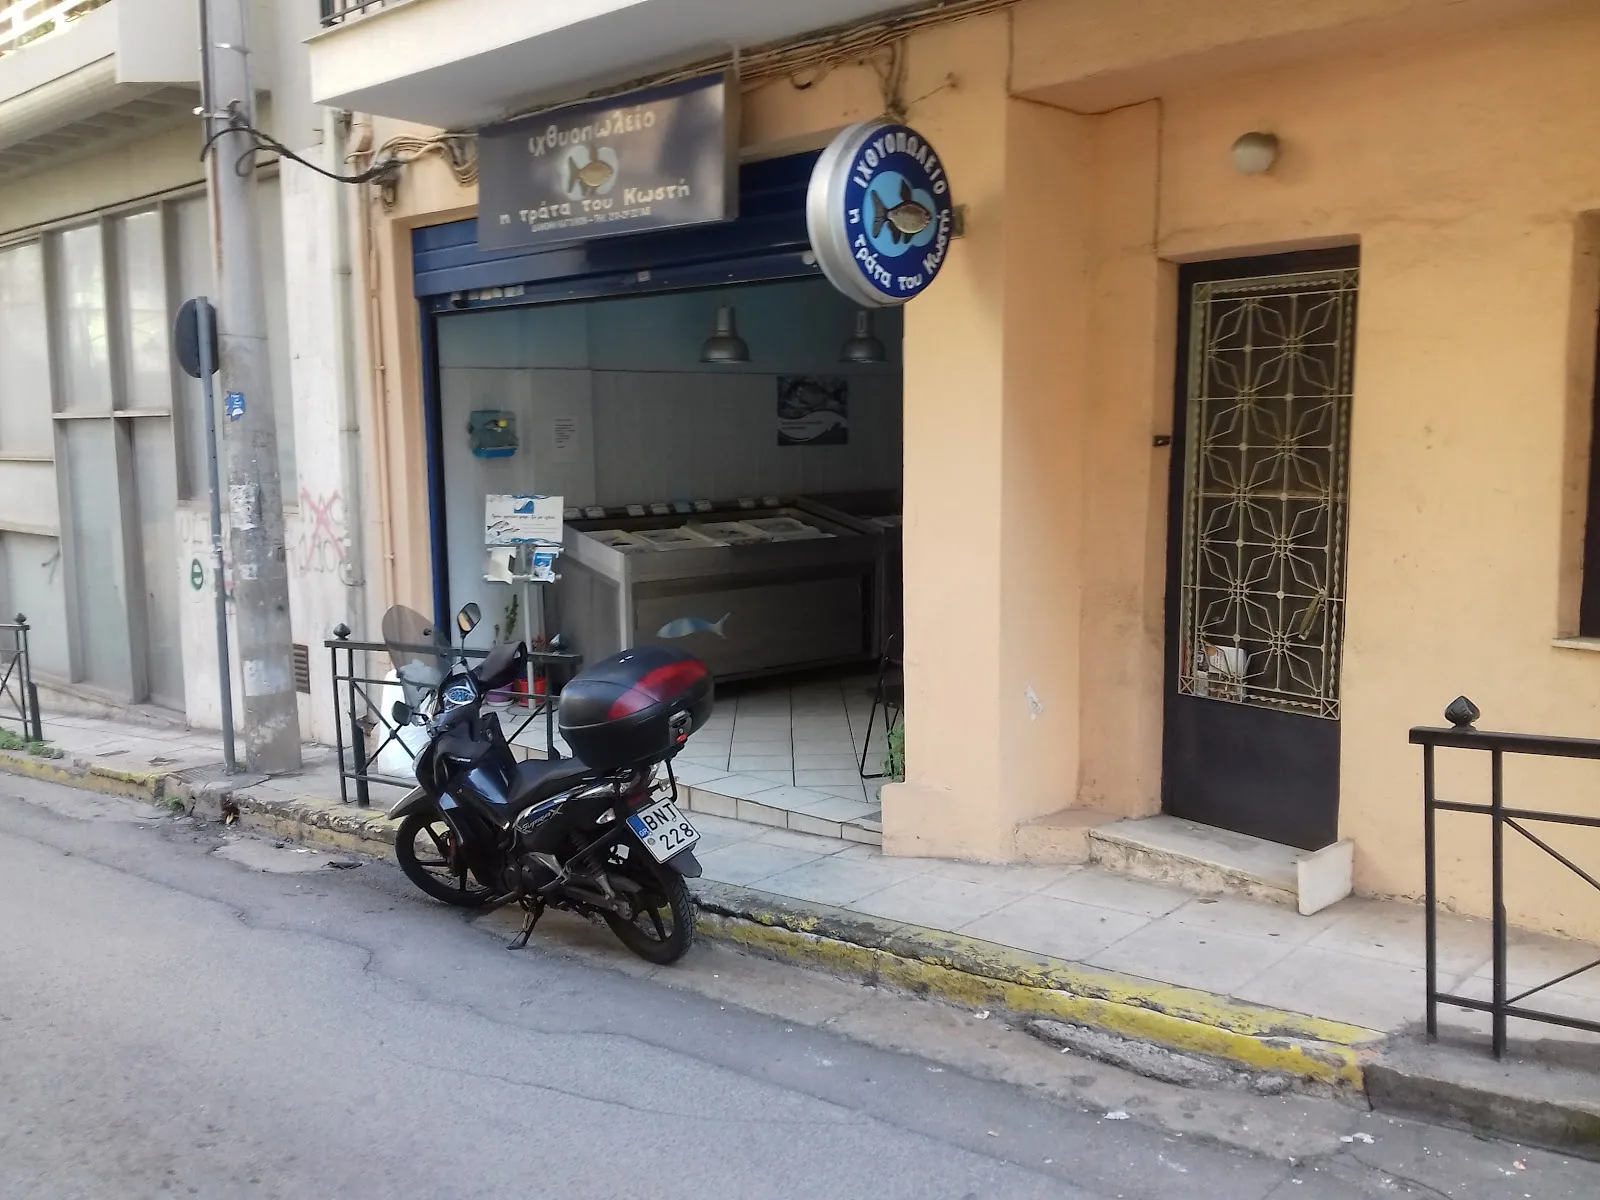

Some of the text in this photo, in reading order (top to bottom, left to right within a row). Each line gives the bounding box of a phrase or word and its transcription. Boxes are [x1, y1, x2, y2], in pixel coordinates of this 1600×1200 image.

[528, 105, 656, 157] ιχθυοπωλείο
[853, 132, 948, 195] ΙΧΘΥΟΠΩΛΕΙΟ
[519, 200, 572, 226] τράτα
[582, 196, 614, 213] του
[623, 178, 692, 206] Κωστή
[848, 208, 950, 291] η τράτα του Κωστή
[638, 827, 650, 838] GR
[642, 803, 678, 831] BNT
[660, 822, 695, 851] 228
